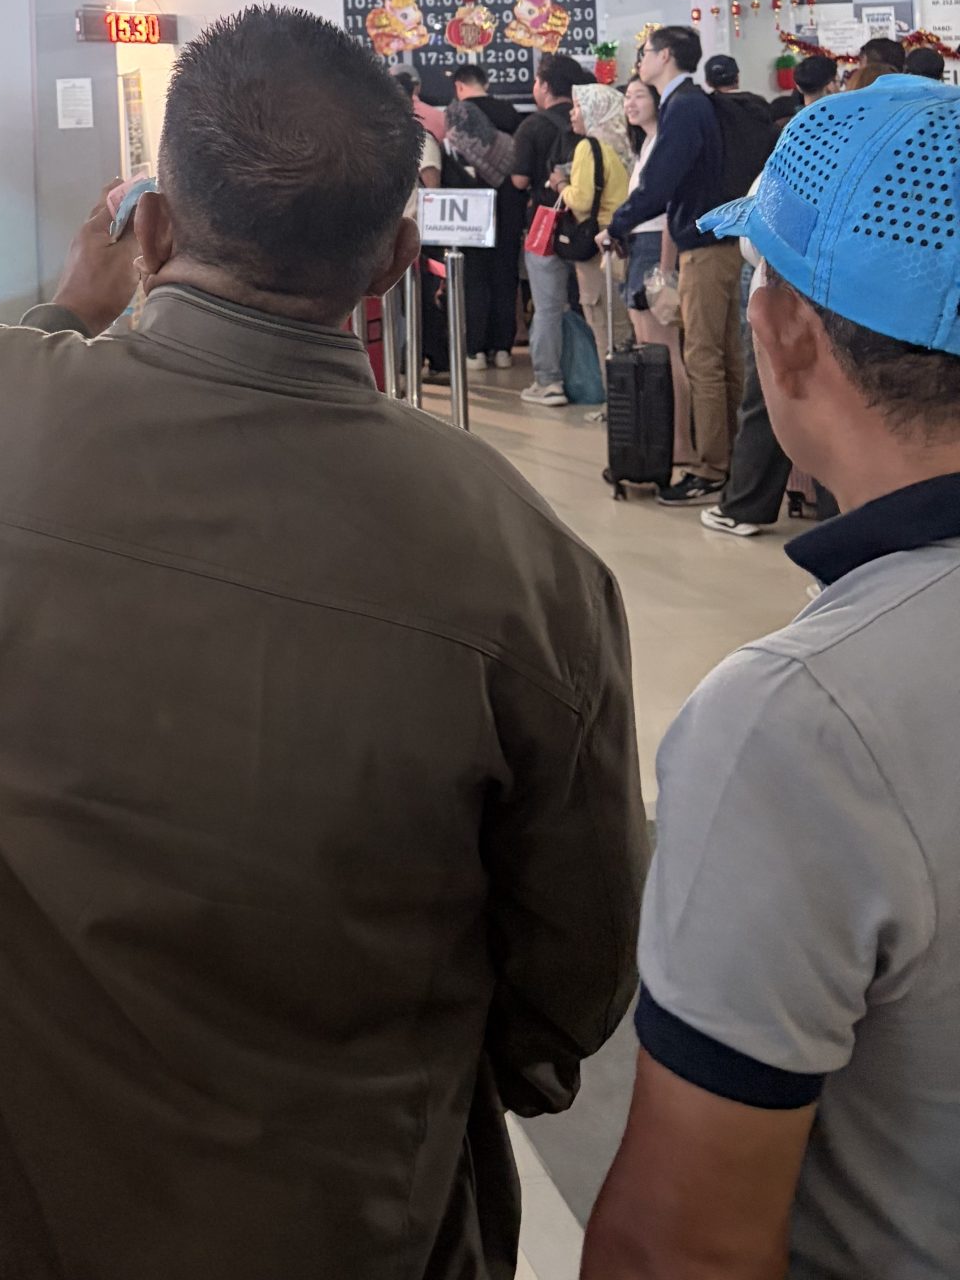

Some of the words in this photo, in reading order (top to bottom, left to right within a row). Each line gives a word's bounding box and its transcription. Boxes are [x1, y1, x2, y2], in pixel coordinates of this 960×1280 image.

[420, 52, 465, 65] 17:30
[488, 68, 529, 82] 2:30
[440, 199, 468, 222] IN
